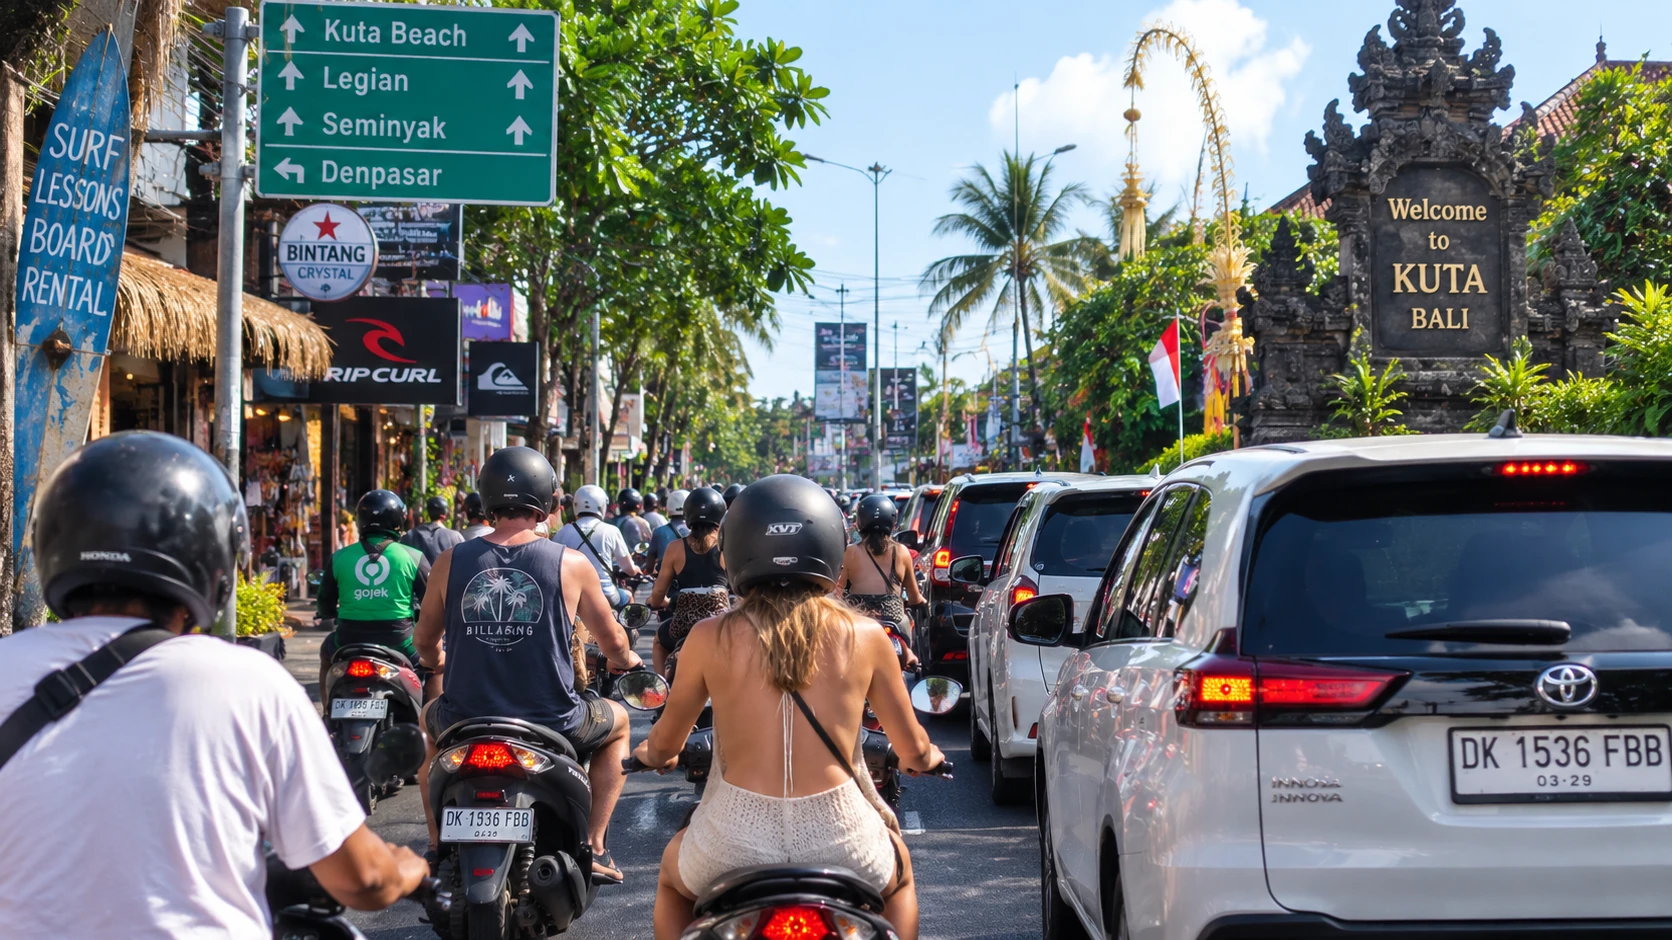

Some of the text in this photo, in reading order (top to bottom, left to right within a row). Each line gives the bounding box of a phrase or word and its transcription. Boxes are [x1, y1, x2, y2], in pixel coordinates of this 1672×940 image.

[324, 18, 466, 47] Kuta Beach
[323, 66, 408, 96] Legian
[322, 112, 447, 144] Seminyak
[49, 122, 125, 170] SURF
[321, 160, 442, 190] Denpasar
[35, 168, 123, 220] LESSONS
[1387, 198, 1487, 221] Welcome
[287, 244, 366, 263] BINTANG
[1428, 231, 1450, 250] to
[297, 267, 354, 280] CRYSTAL
[1392, 263, 1488, 294] KUTA
[22, 266, 107, 317] RENTAL
[1411, 307, 1470, 329] BALI
[323, 367, 442, 383] RIP CURL
[80, 551, 132, 562] HONDA
[354, 587, 389, 600] gojek
[1461, 734, 1663, 769] DK 1536 FBB
[446, 811, 463, 826] DK
[505, 811, 529, 827] FBB
